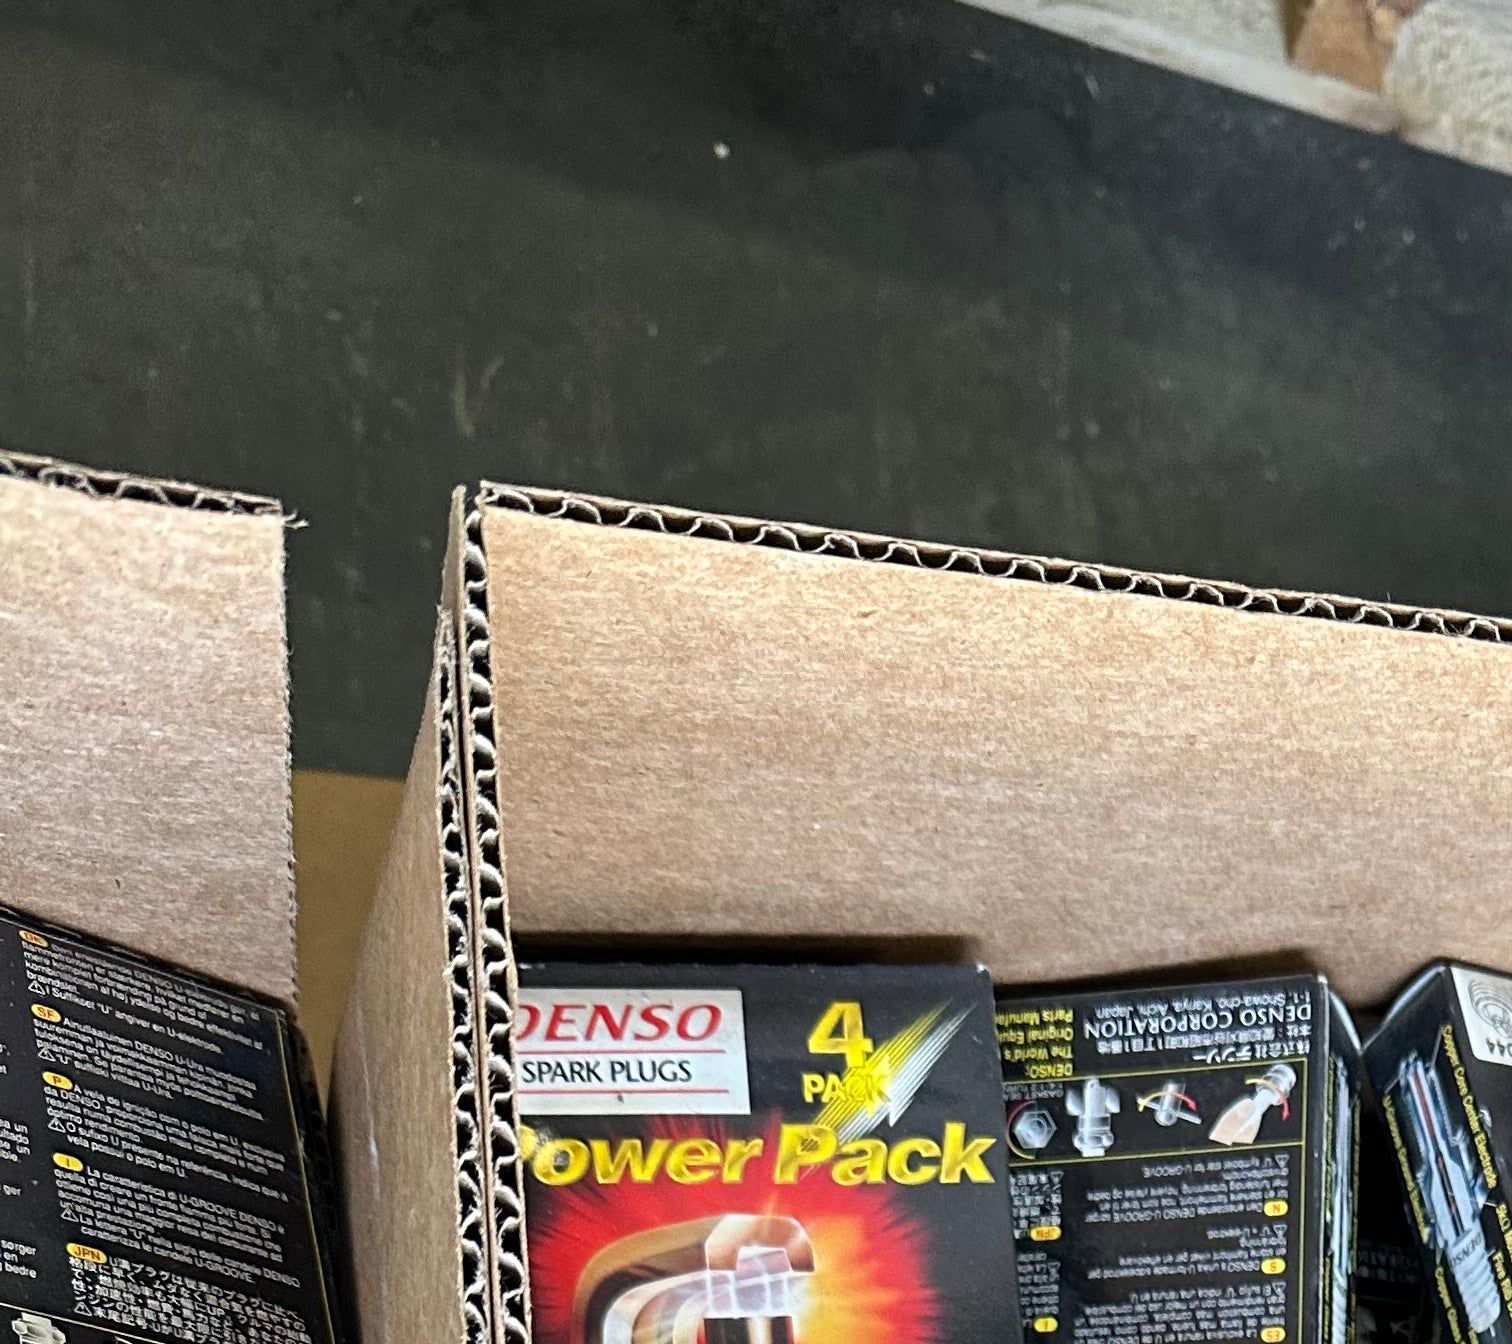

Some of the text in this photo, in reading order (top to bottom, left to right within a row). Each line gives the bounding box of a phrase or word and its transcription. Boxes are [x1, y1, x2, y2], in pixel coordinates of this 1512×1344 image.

[1084, 1010, 1235, 1039] CORPORATION
[1258, 1004, 1311, 1026] DENSO
[808, 1001, 873, 1061] 4
[522, 1060, 692, 1083] SPARK PLUGS
[803, 1071, 889, 1104] PACK
[519, 1122, 995, 1184] ower Pack
